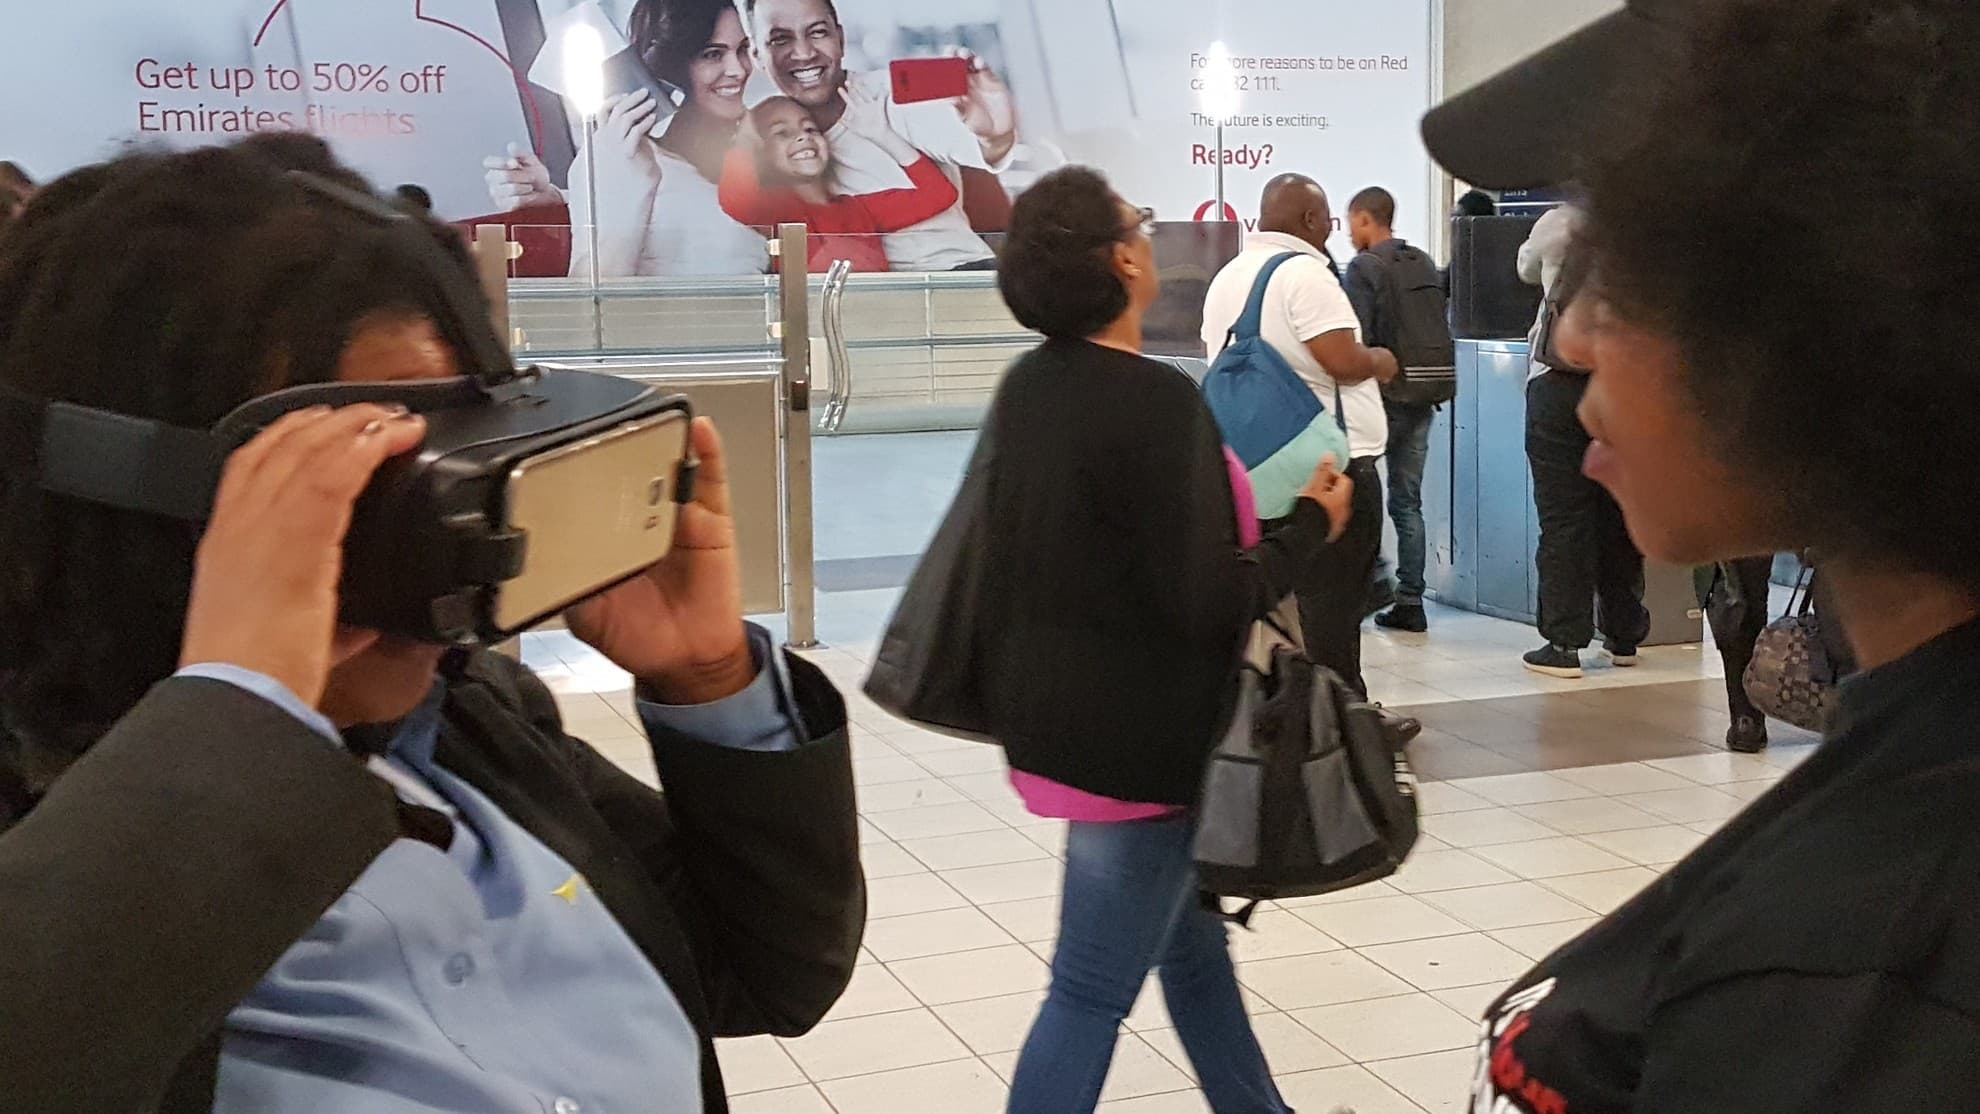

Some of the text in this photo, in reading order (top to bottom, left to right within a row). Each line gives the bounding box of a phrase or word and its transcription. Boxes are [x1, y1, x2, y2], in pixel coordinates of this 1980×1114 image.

[1190, 53, 1408, 70] Fo ore reasons to be on Red
[135, 58, 447, 98] Get up to 50% off
[1253, 75, 1281, 92] 111.
[138, 101, 294, 133] Emirates
[1190, 113, 1329, 130] The uture is exciting.
[1191, 144, 1274, 170] Ready?
